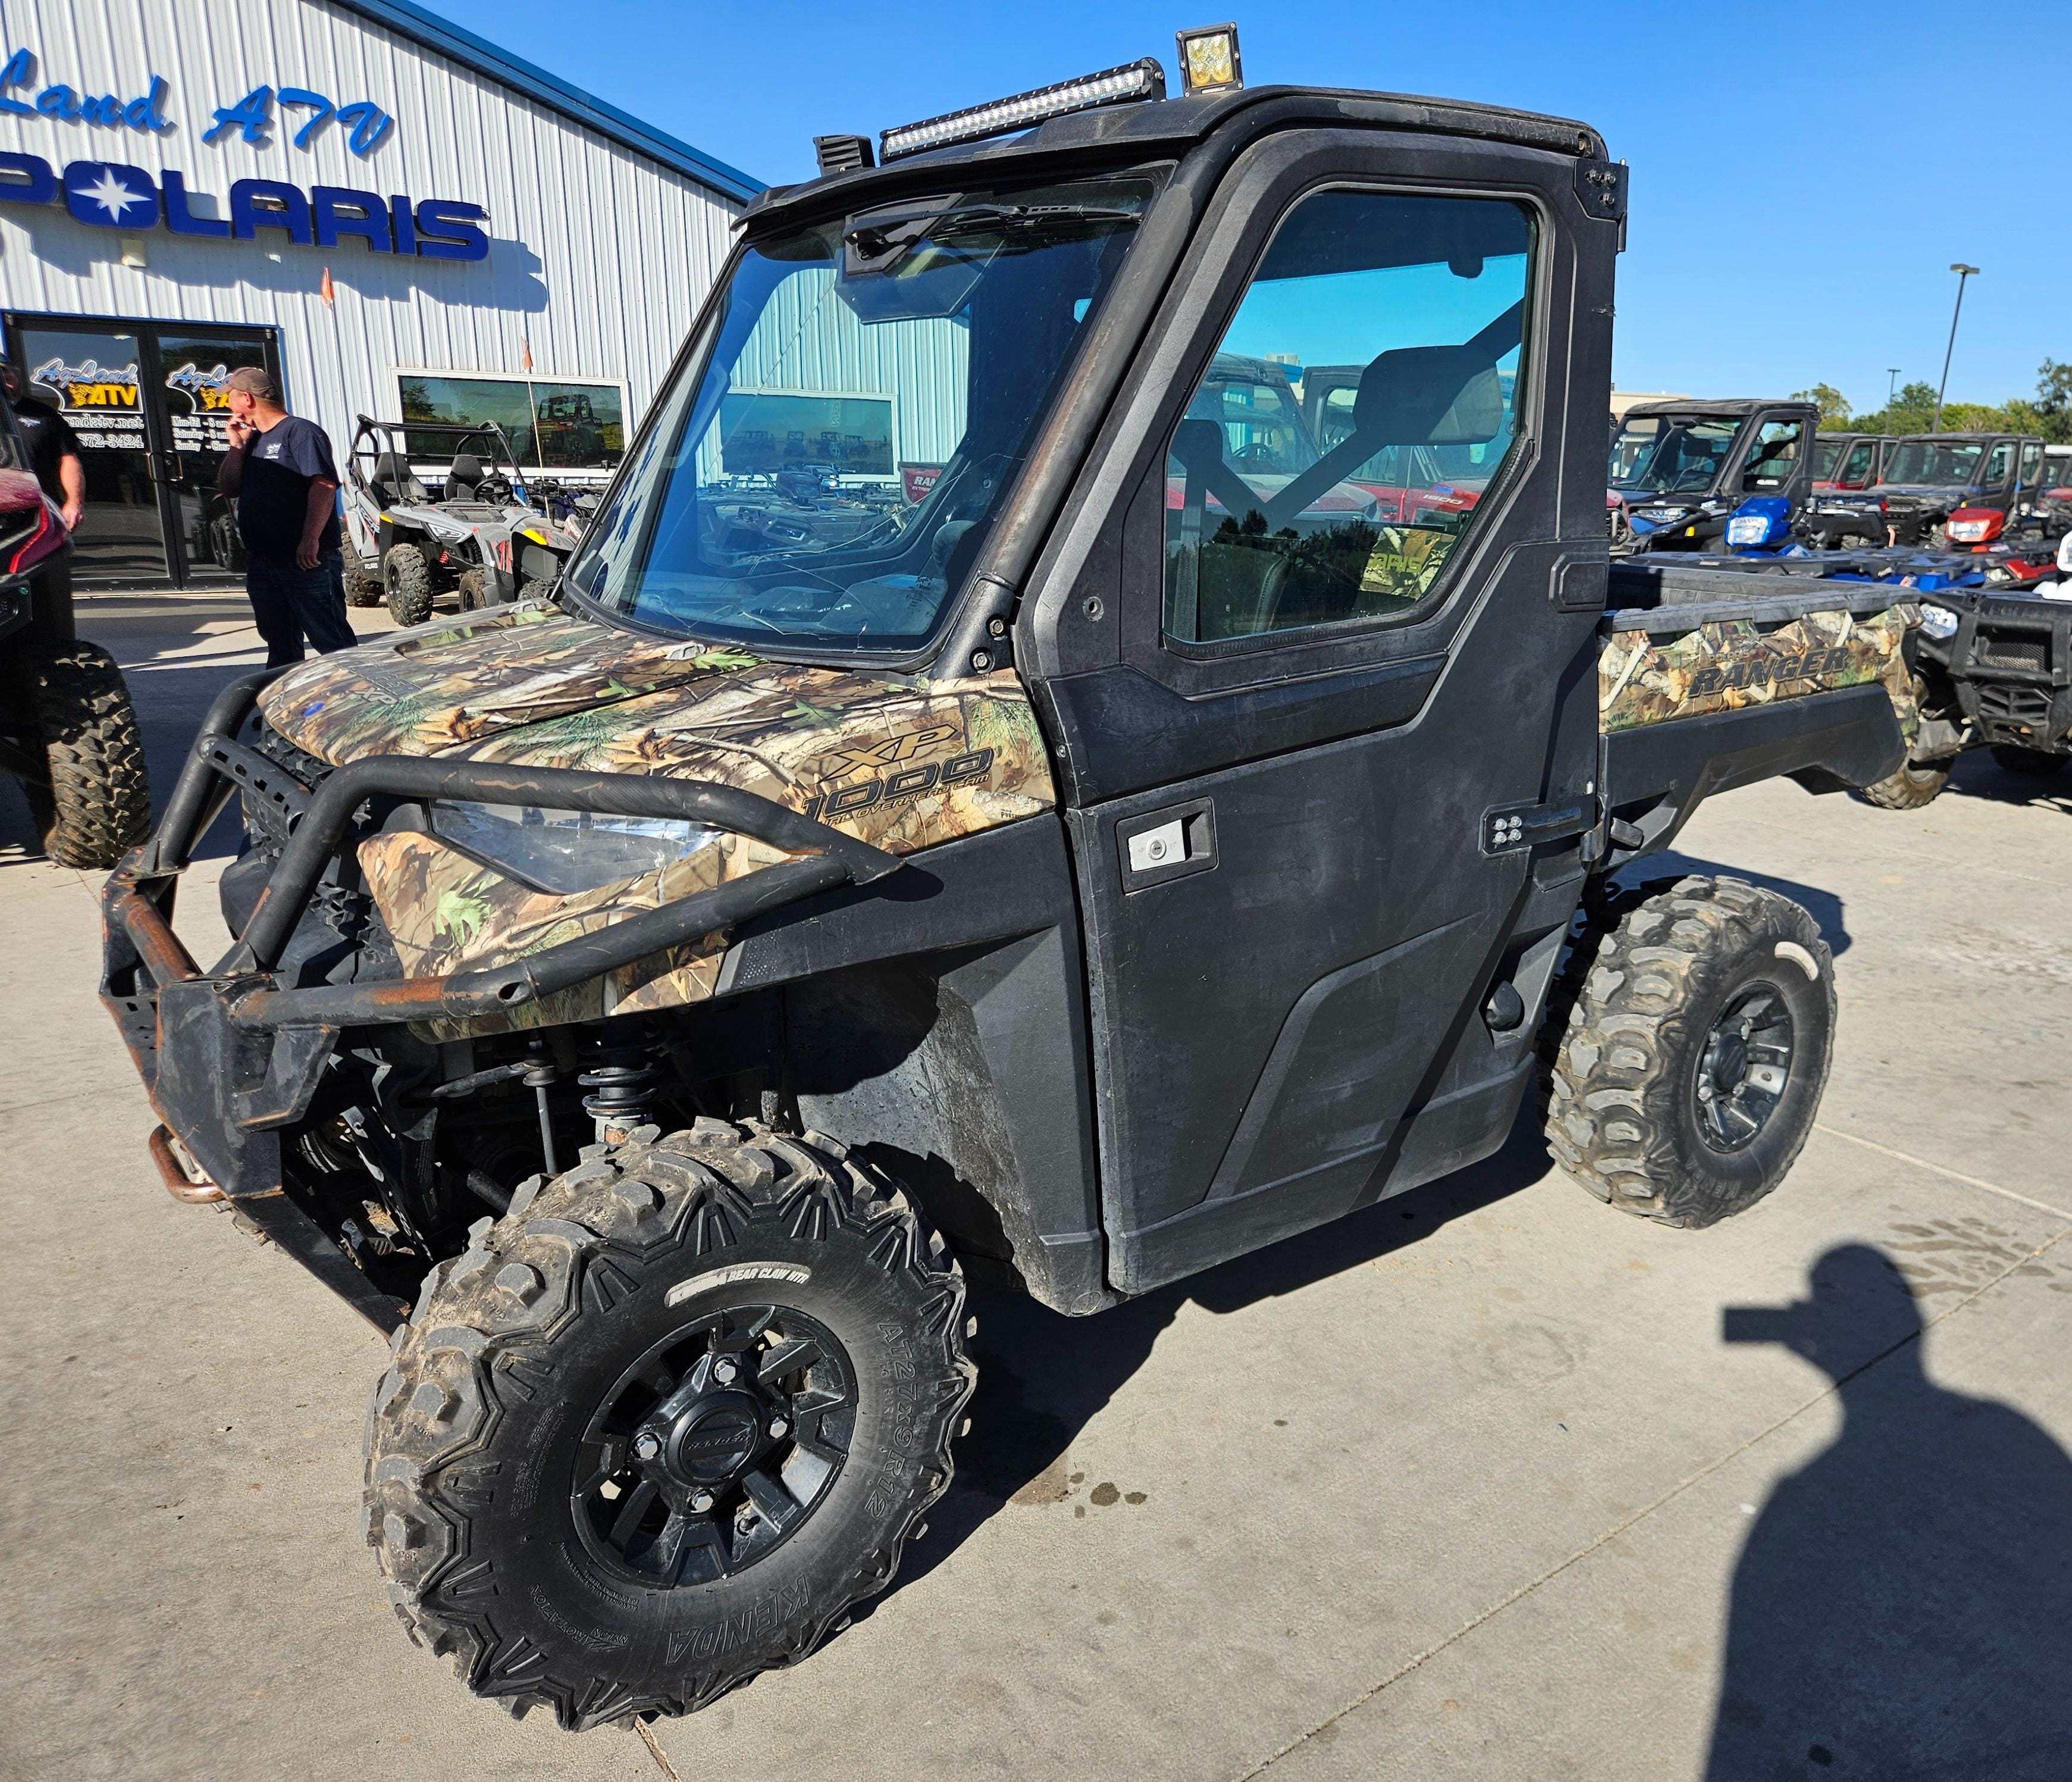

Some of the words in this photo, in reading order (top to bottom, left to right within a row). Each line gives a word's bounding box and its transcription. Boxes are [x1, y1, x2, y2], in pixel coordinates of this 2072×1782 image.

[0, 48, 173, 131] Land
[202, 84, 391, 156] ATV
[0, 152, 490, 261] POLARIS
[33, 358, 138, 389] Ag-Land
[89, 384, 137, 406] ATV
[172, 416, 201, 427] Mon-Fri
[173, 428, 204, 440] Saturday
[175, 440, 201, 452] Sunday
[1368, 552, 1423, 573] ARIS
[1688, 647, 1849, 699] RANGER
[815, 723, 959, 784] XP
[801, 747, 995, 822] 1000
[857, 785, 951, 818] OVERHEAD
[952, 774, 990, 790] CAM
[727, 1268, 758, 1282] BEAR
[757, 1267, 791, 1279] CLAW
[786, 1270, 810, 1285] HTR
[865, 1324, 918, 1518] AT27x9R12
[591, 1627, 630, 1644] NYLON
[666, 1574, 810, 1665] KENDA
